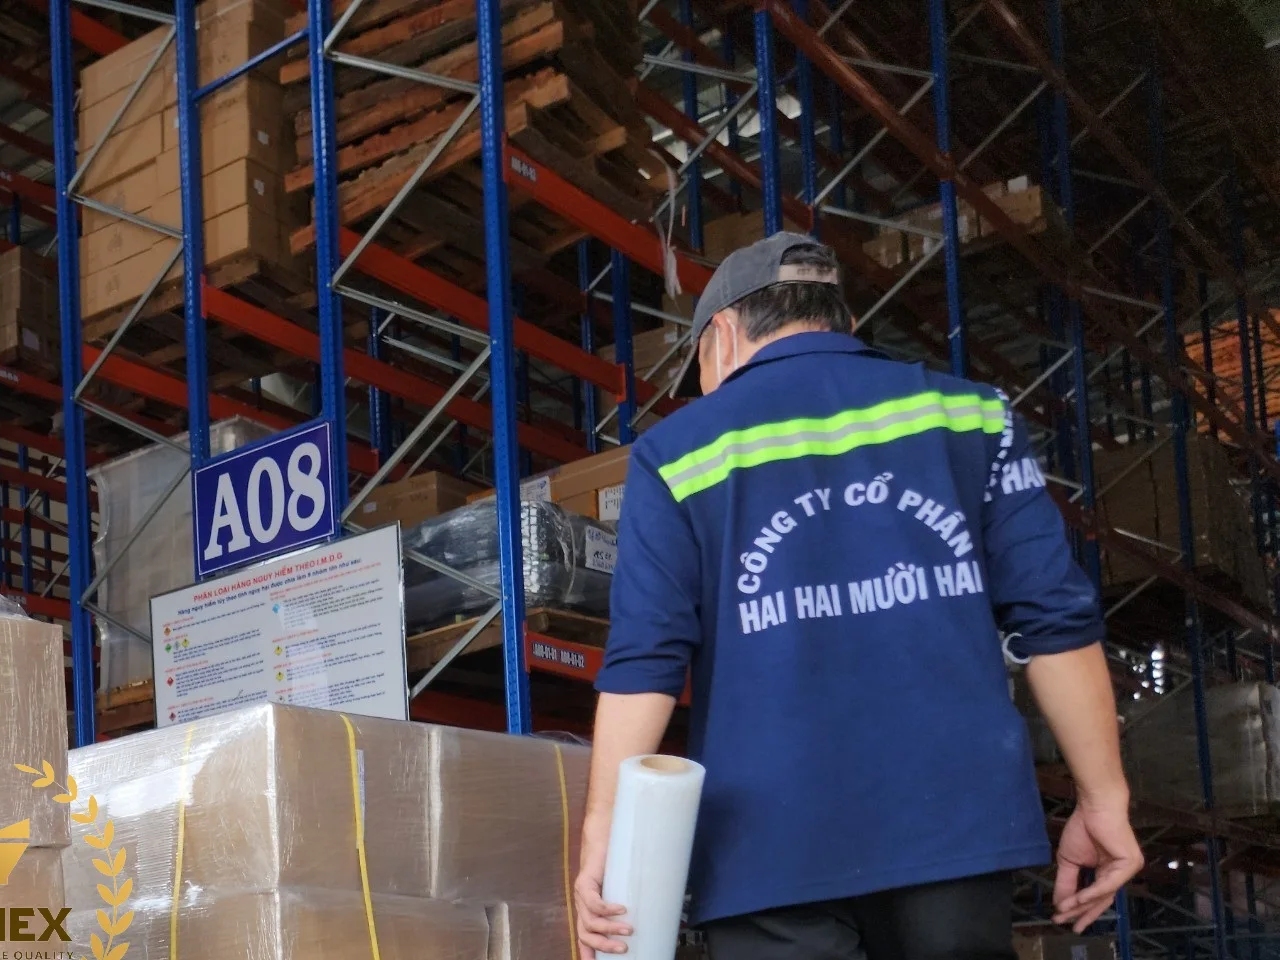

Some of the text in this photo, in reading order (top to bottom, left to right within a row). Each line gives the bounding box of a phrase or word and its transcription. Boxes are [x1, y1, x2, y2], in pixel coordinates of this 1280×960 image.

[203, 441, 326, 561] A08
[737, 510, 798, 595] CÔNG
[793, 487, 832, 517] TY
[844, 471, 895, 507] CỔ
[295, 560, 316, 572] THEO
[738, 560, 984, 635] HAI HAI MƯỜI HAI
